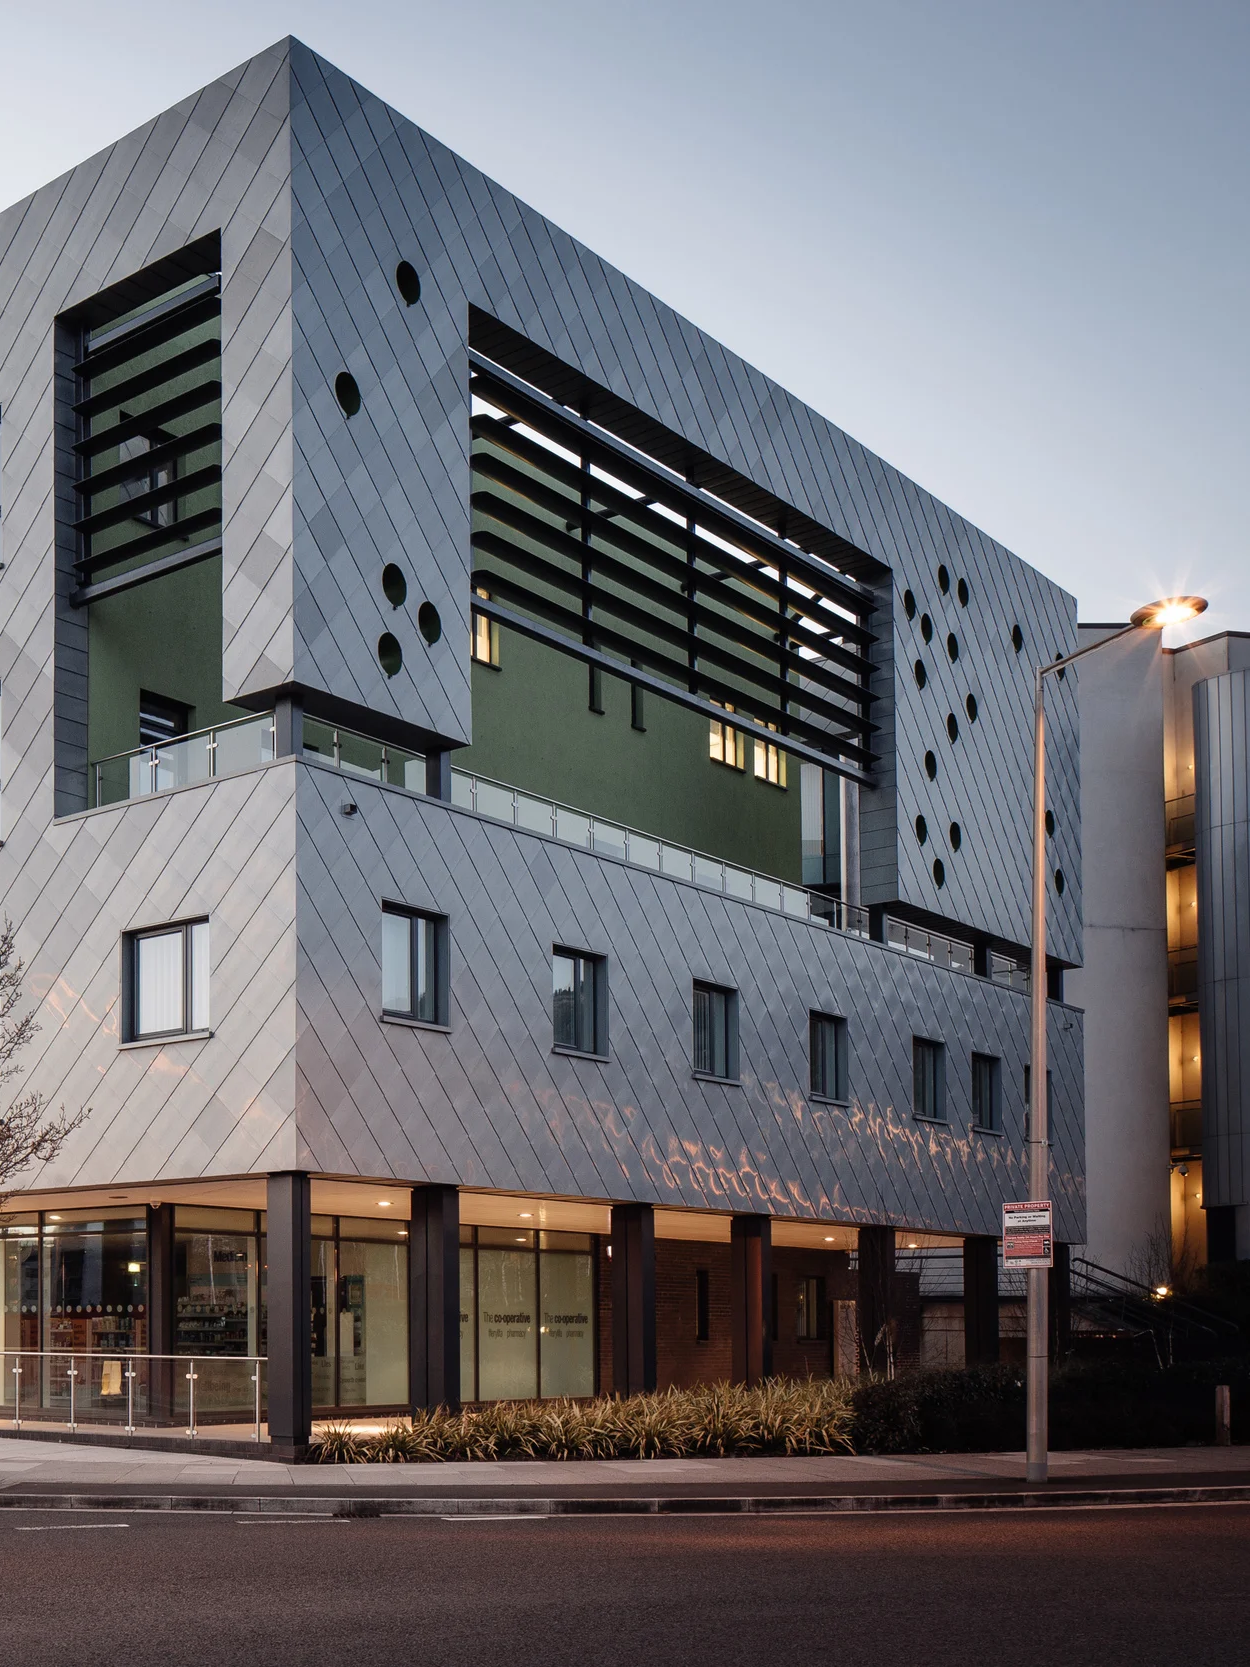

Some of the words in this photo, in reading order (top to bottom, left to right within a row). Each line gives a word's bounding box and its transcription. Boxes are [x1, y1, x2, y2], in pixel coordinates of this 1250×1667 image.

[483, 1312, 494, 1323] The
[494, 1312, 531, 1326] co-operative
[544, 1313, 554, 1323] The
[554, 1313, 588, 1326] co-operative
[507, 1329, 526, 1339] pharmacy
[566, 1330, 584, 1339] pharmacy
